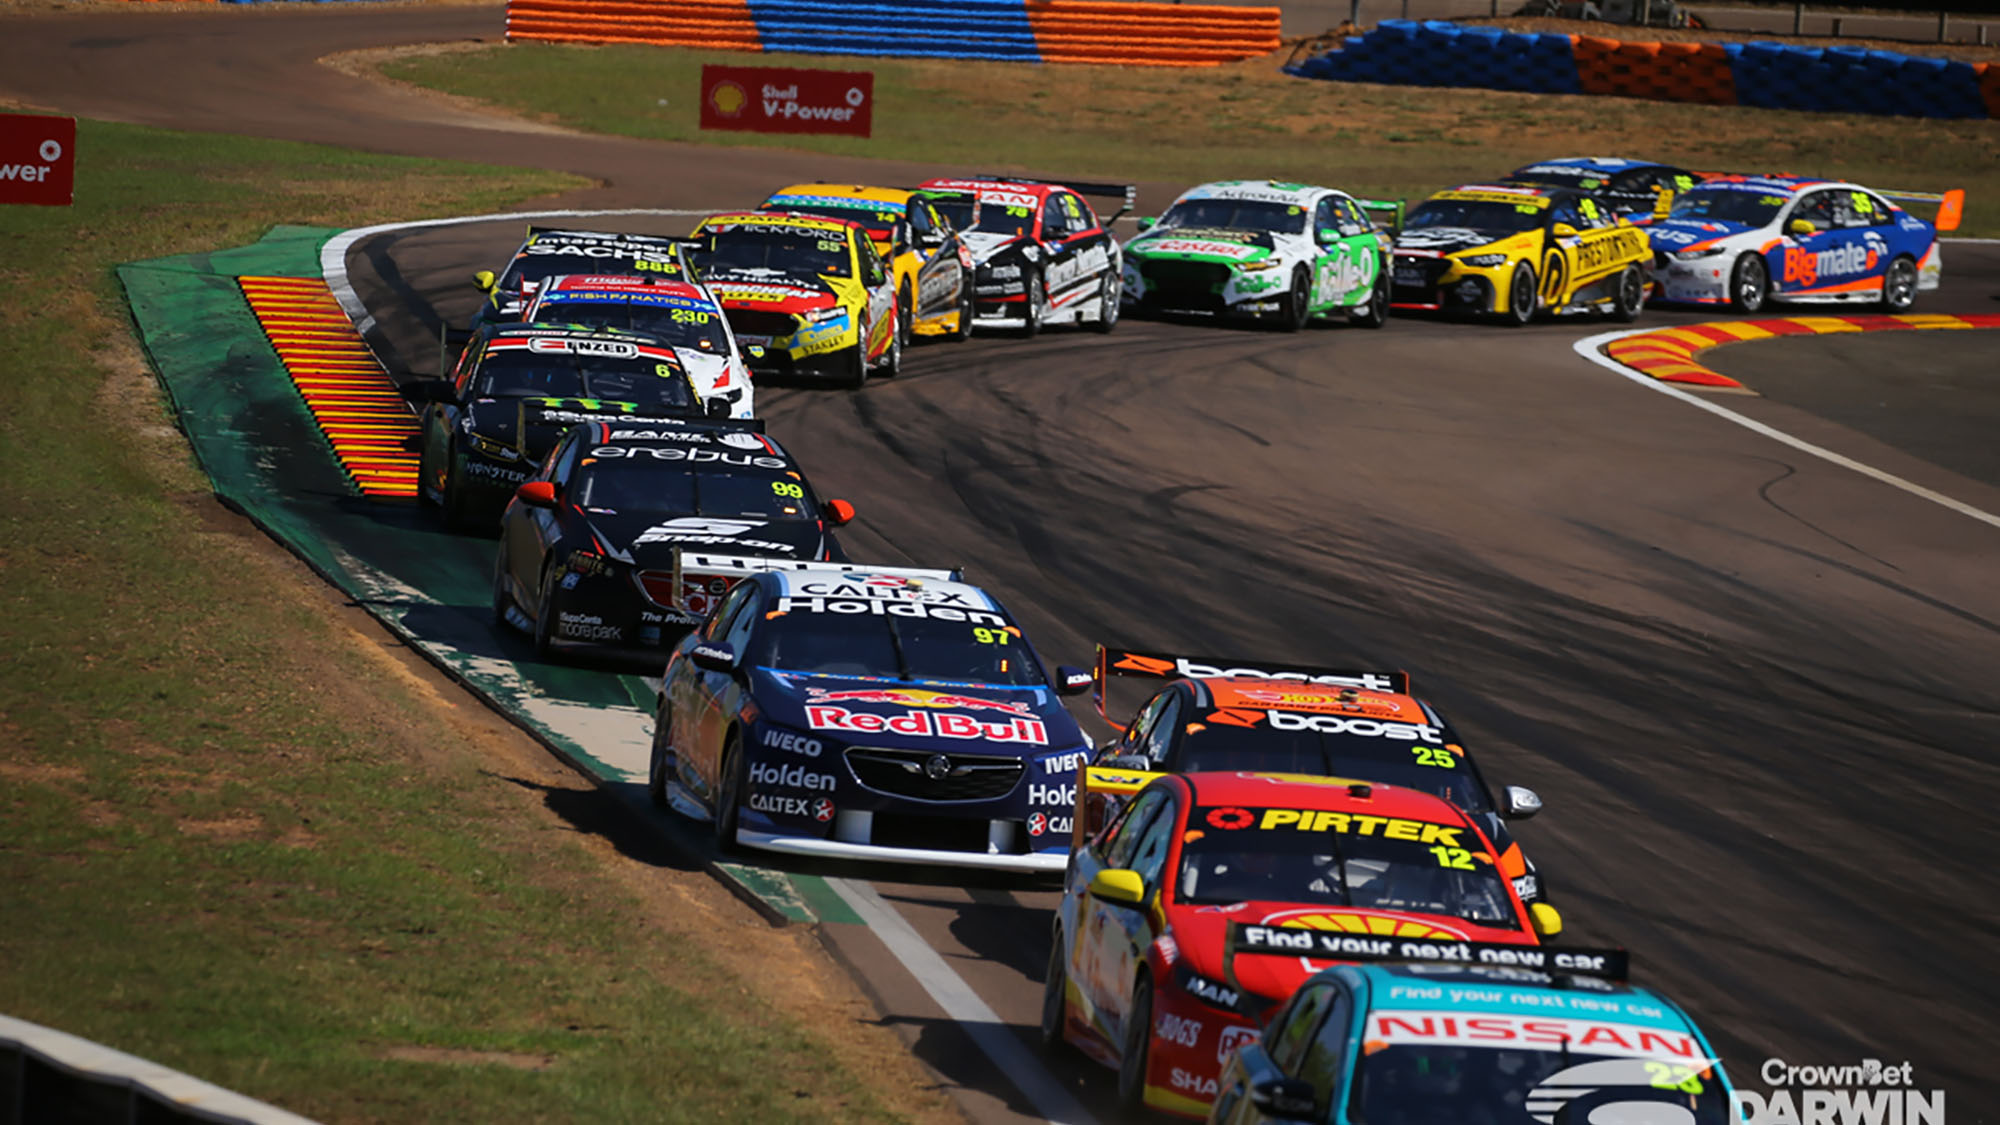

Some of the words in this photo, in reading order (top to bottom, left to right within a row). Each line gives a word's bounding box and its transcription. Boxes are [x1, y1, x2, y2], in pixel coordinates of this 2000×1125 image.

[762, 84, 798, 99] Shell
[763, 101, 855, 121] V-Power
[526, 244, 671, 263] SACHS
[817, 239, 841, 252] 55
[634, 260, 678, 274] 888
[569, 292, 607, 300] FISH
[610, 293, 692, 307] FANATICS
[671, 308, 709, 324] 230
[567, 340, 628, 354] ENZED
[655, 364, 671, 378] 6
[591, 446, 787, 468] erebus
[466, 462, 526, 483] MONSTER
[771, 481, 803, 498] 99
[800, 583, 970, 606] CALTEX
[642, 611, 662, 623] The
[778, 597, 1007, 626] Holden
[973, 627, 1009, 646] 97
[804, 705, 933, 736] Red
[933, 712, 1050, 745] Bull
[1268, 709, 1443, 744] boost
[763, 730, 823, 758] IVECO
[1411, 746, 1456, 769] 25
[750, 762, 837, 792] Holden
[750, 793, 809, 817] CALTEX
[1259, 808, 1465, 848] PIRTEK
[1429, 845, 1476, 871] 12
[1245, 928, 1313, 949] Find
[1320, 936, 1392, 956] your
[1401, 941, 1473, 960] next
[1479, 948, 1545, 966] new
[1554, 953, 1605, 970] car
[1391, 986, 1442, 999] Find
[1448, 988, 1504, 1003] your
[1510, 992, 1566, 1008] next
[1571, 999, 1622, 1014] new
[1626, 1003, 1663, 1019] car
[1378, 1015, 1694, 1058] NISSAN
